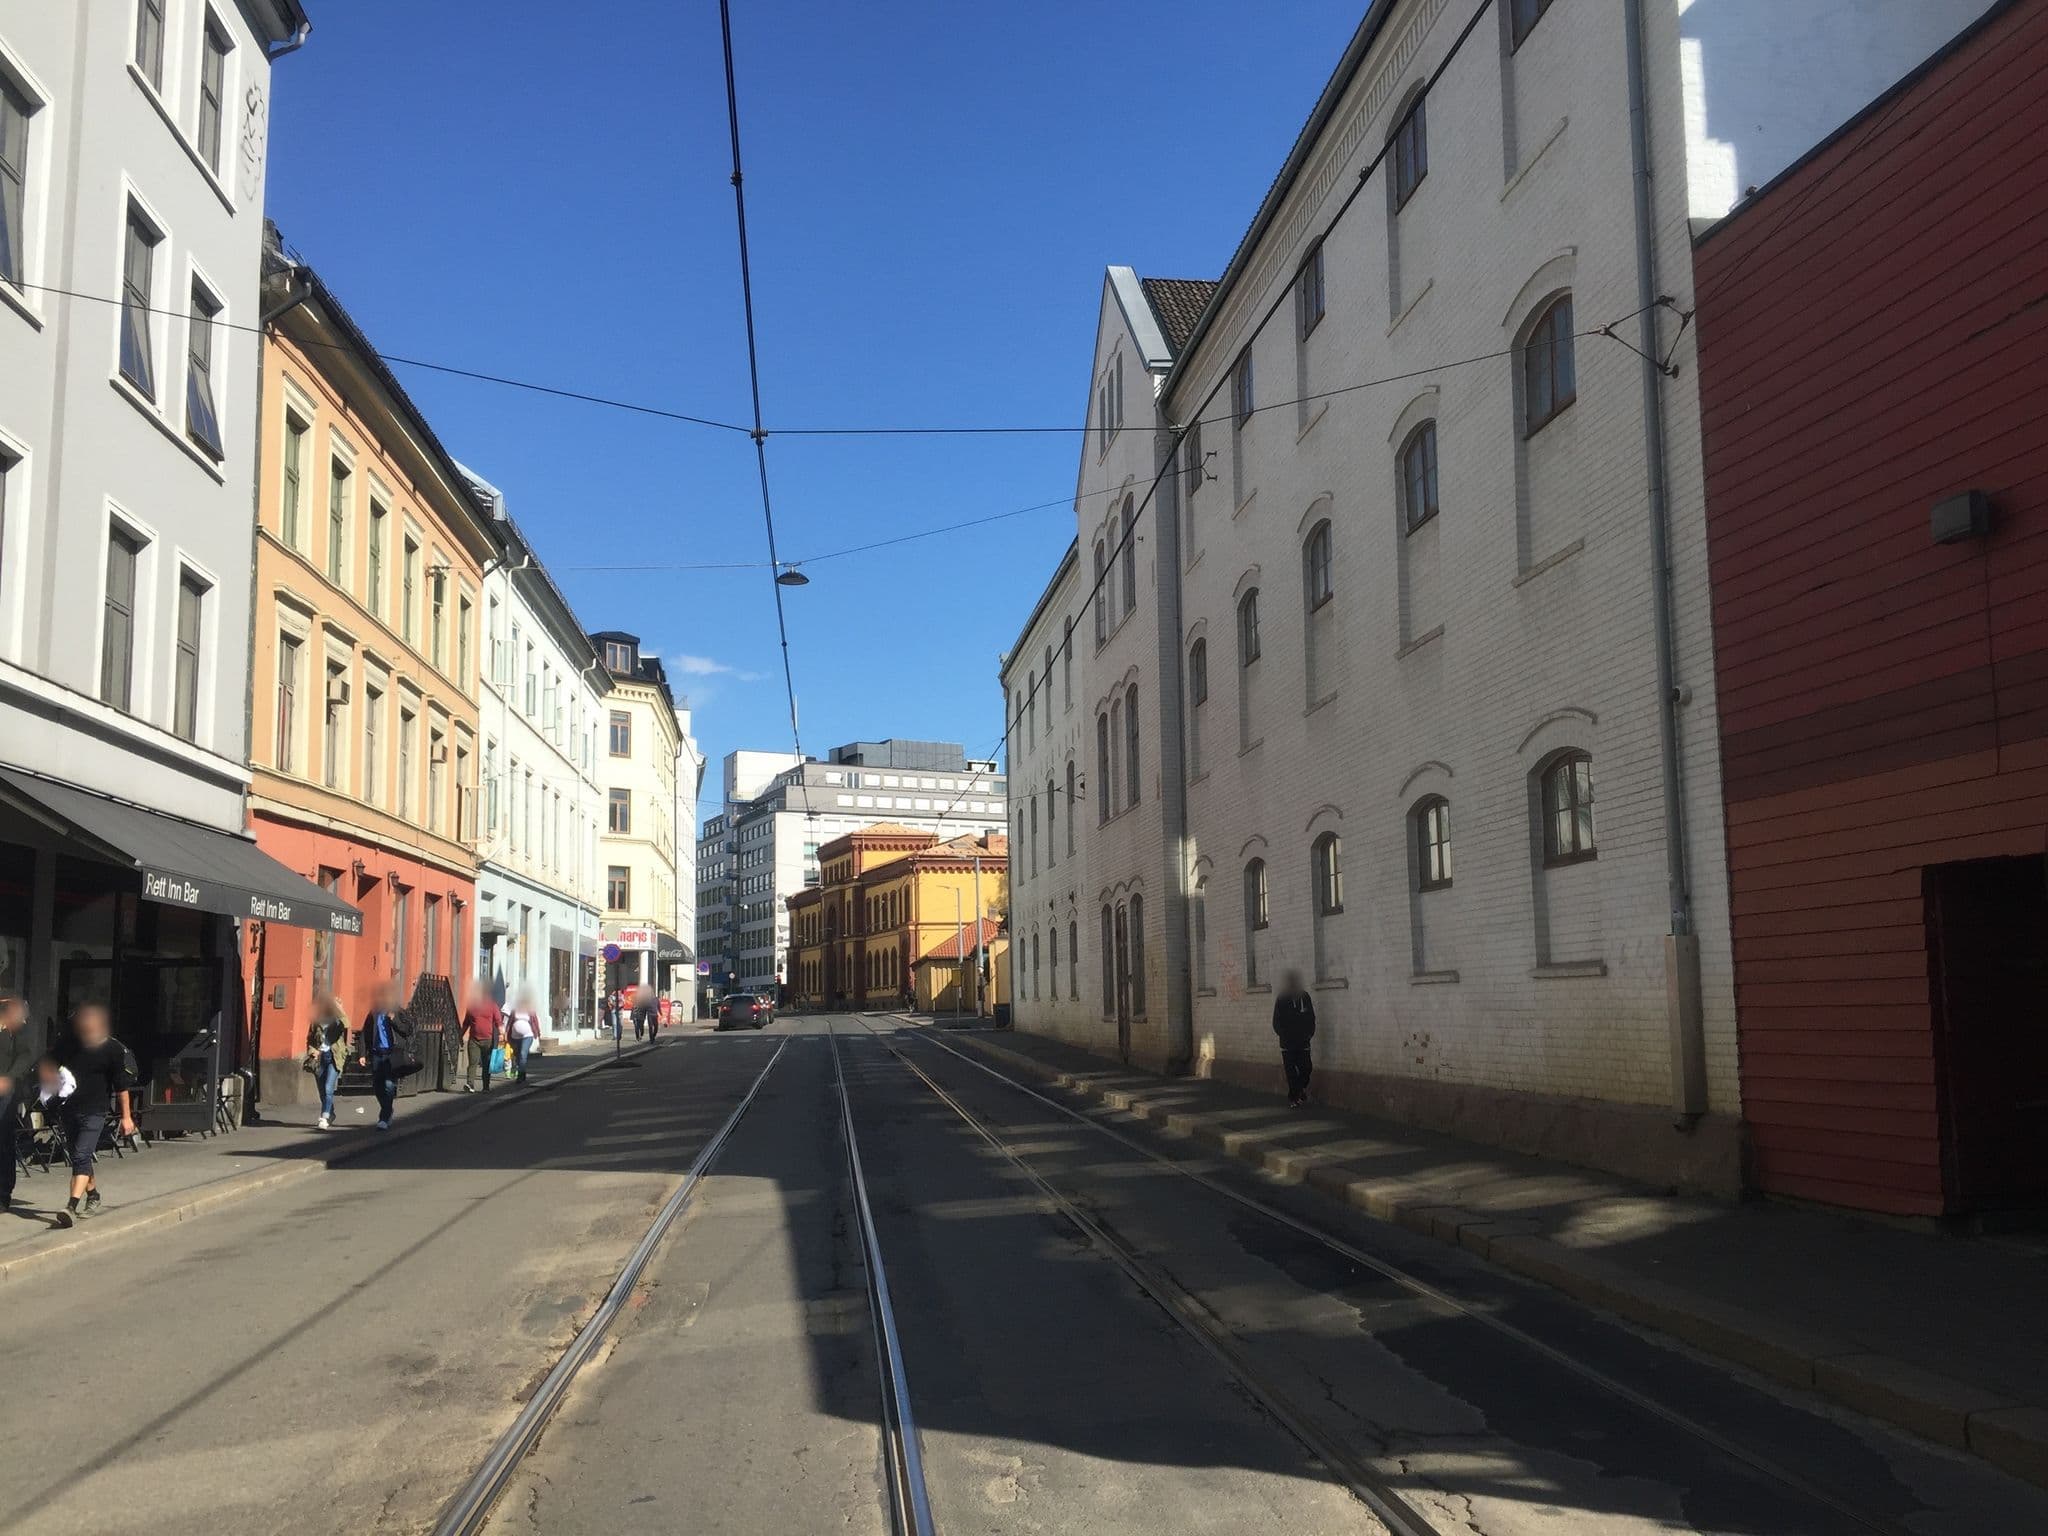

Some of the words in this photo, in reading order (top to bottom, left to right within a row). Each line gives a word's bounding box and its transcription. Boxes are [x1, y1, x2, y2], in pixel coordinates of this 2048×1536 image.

[145, 872, 166, 898] Rett
[167, 877, 182, 900] Inn
[183, 881, 200, 904] Bar
[250, 896, 266, 917] Rett
[266, 899, 278, 919] Inn
[278, 901, 291, 920] Bar
